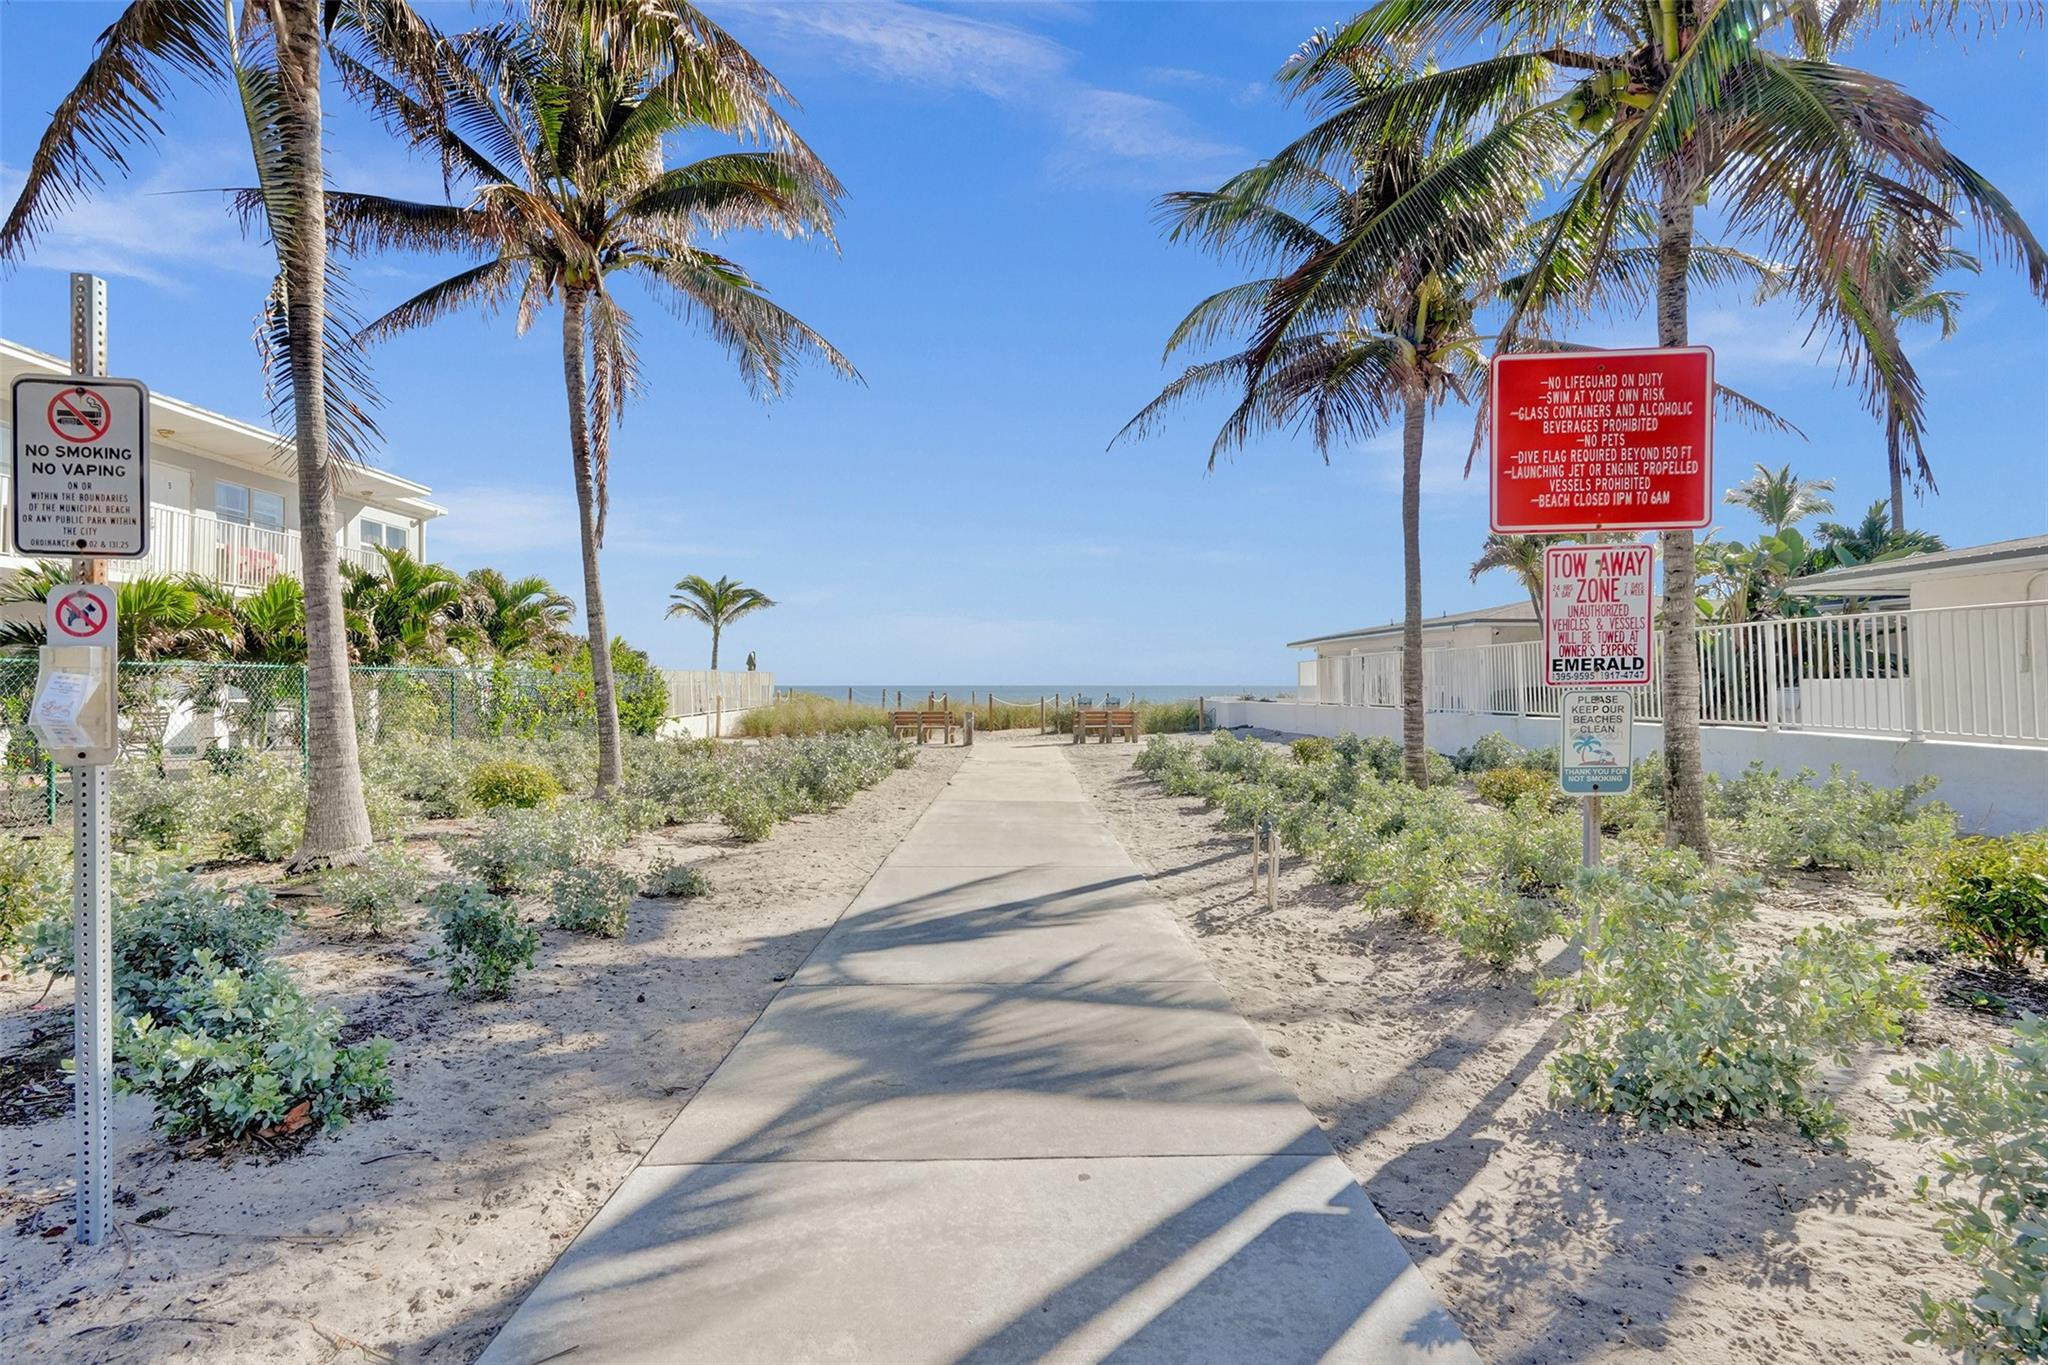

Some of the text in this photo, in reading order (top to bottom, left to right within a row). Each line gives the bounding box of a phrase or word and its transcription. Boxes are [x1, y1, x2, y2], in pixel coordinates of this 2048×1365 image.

[1565, 374, 1617, 388] LIFEGUARD
[1622, 374, 1634, 387] ON
[1639, 373, 1663, 386] DUTY
[1574, 391, 1584, 403] AT
[1589, 389, 1614, 402] YOUR
[1619, 388, 1638, 402] OWN
[1643, 387, 1665, 401] RISK
[1553, 404, 1611, 419] CONTAINERS
[1616, 403, 1633, 417] AND
[1639, 402, 1693, 417] ALCOHOLIC
[1543, 417, 1658, 434] BEVERAGES PROHIBITED
[1602, 433, 1625, 446] PETS
[25, 444, 132, 460] NO SMOKING
[1543, 450, 1566, 463] FLAG
[1571, 448, 1616, 462] REQUIRED
[1621, 447, 1658, 461] BEYOND
[1662, 446, 1678, 460] 150
[1681, 446, 1692, 459] FT
[32, 462, 126, 477] NO VAPING
[1568, 464, 1584, 477] JET
[1589, 463, 1602, 477] OR
[1606, 462, 1639, 476] ENGINE
[1643, 461, 1698, 475] PROPELLED
[68, 482, 92, 490] ON OR
[1550, 477, 1650, 492] VESSELS PROHIBITED
[31, 492, 128, 502] WITHIN THE BOUNDARIES
[1574, 493, 1609, 507] CLOSED
[1613, 492, 1632, 505] 11PM
[1636, 492, 1648, 504] TO
[1651, 491, 1670, 504] 6AM
[29, 503, 130, 514] OF THE MUNICIPAL BEACH
[36, 515, 52, 523] ANY
[56, 516, 83, 524] PUBLIC
[87, 516, 107, 525] PARK
[111, 517, 137, 526] WITHIN
[63, 527, 98, 536] THE CITY
[101, 541, 105, 549] &
[1552, 551, 1646, 578] TOW AWAY
[1576, 578, 1620, 603] ZONE
[1568, 604, 1629, 618] UNAUTHORIZED
[1553, 617, 1645, 631] VEHICLES & VESSELS
[1558, 630, 1638, 644] WILL BE TOWED AT
[1559, 644, 1638, 657] OWNER'S EXPENSE
[1552, 658, 1644, 672] EMERALD
[1578, 696, 1618, 704] PLEASE
[1572, 705, 1624, 713] KEEP OUR
[1573, 715, 1622, 724] BEACHES
